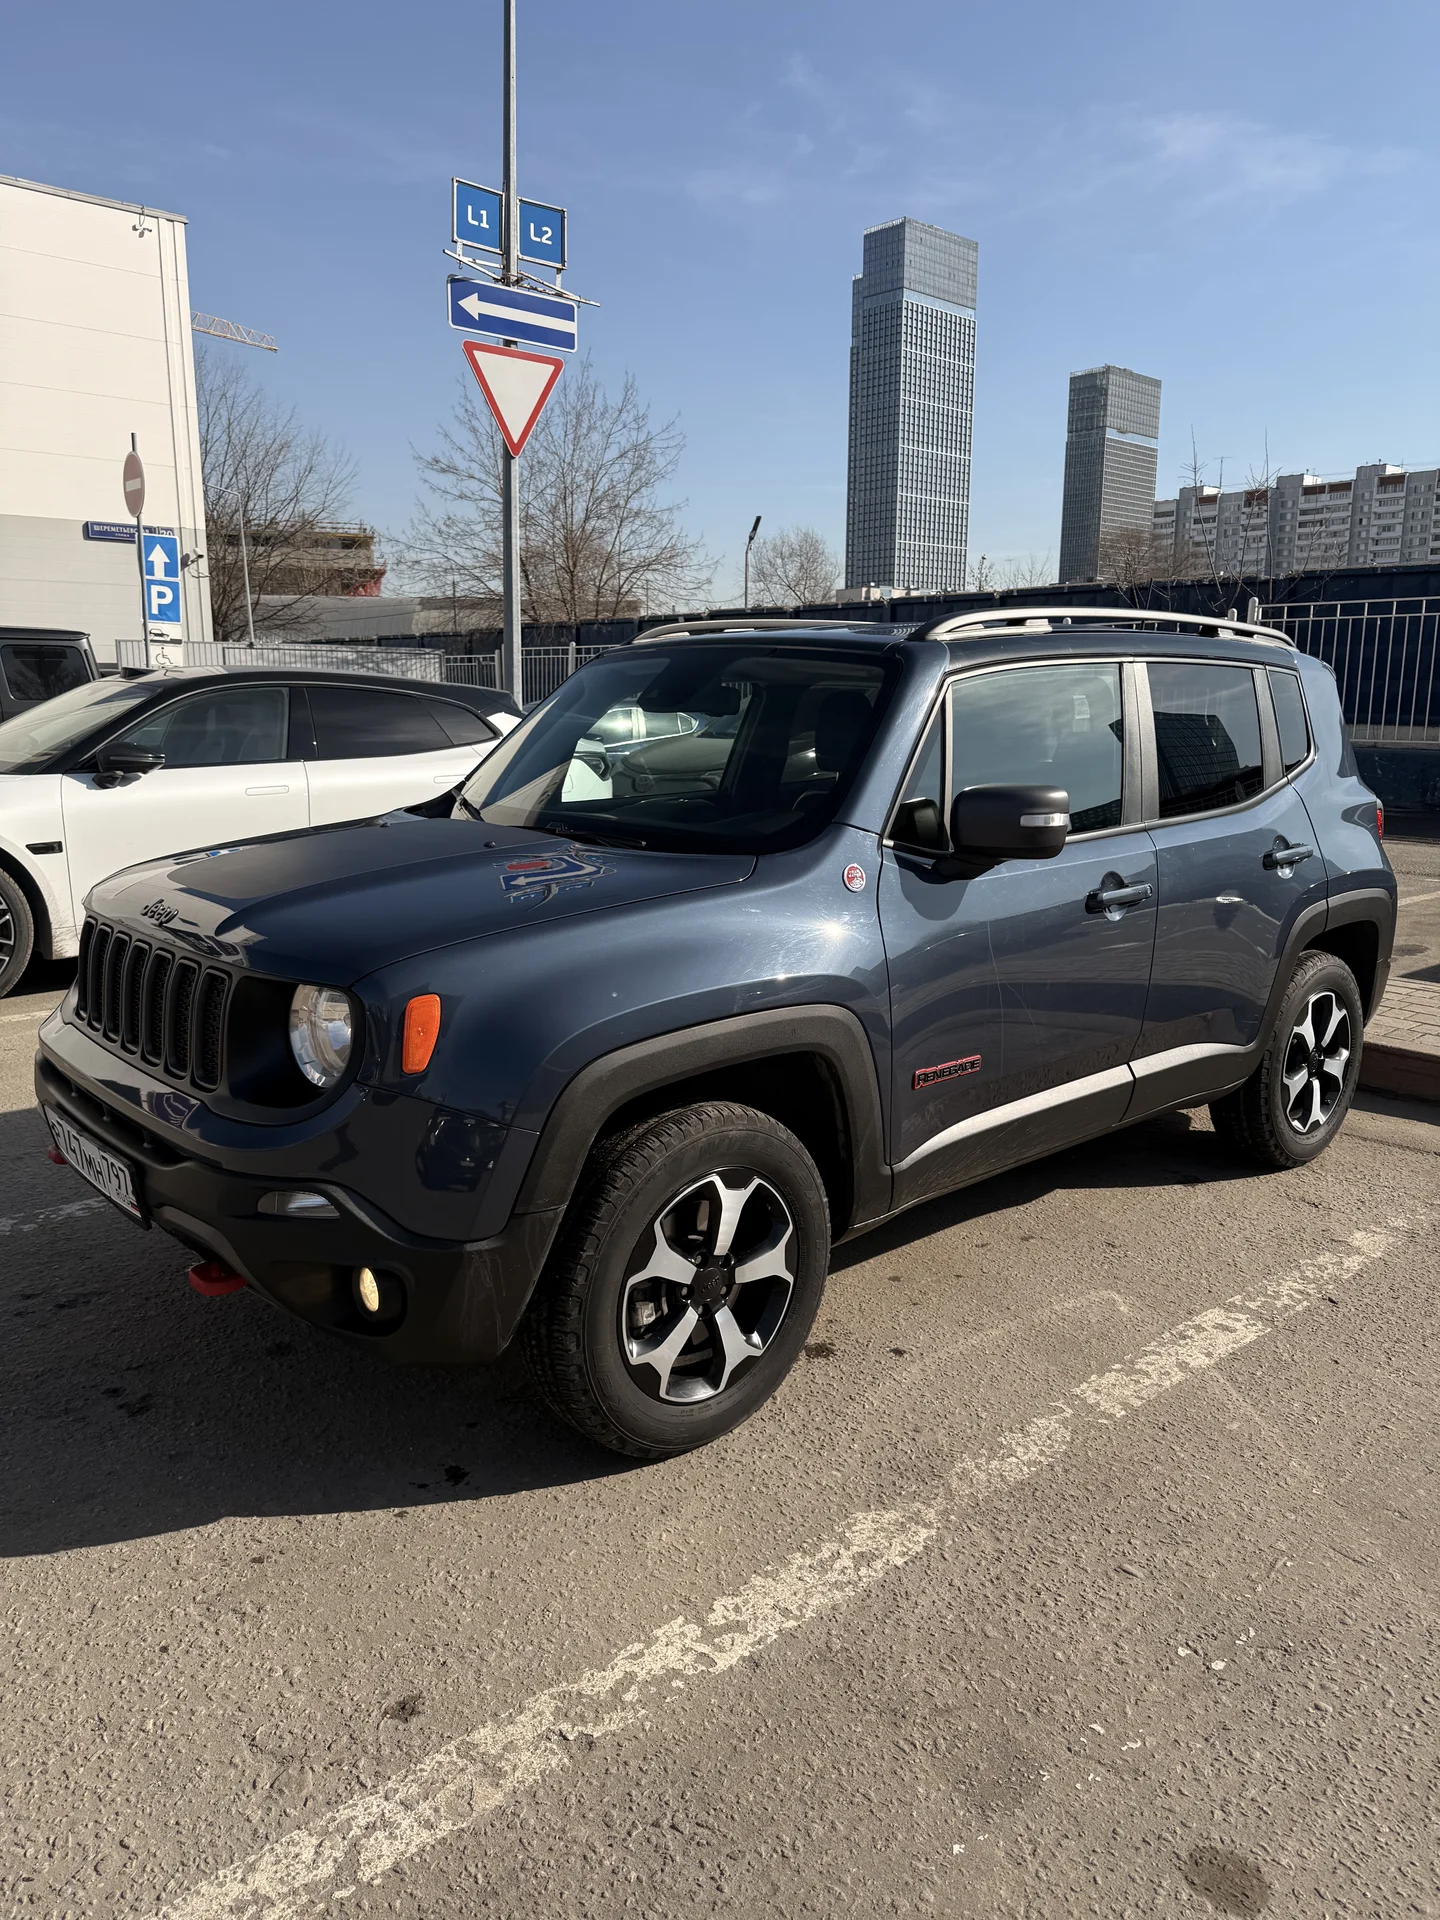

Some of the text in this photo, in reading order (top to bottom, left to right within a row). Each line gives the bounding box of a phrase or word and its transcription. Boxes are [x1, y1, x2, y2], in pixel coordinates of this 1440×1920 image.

[467, 204, 489, 229] L1
[529, 222, 552, 245] L2
[93, 524, 149, 534] ШЕРЕМЕТЬЕВСЯ
[150, 584, 173, 615] P
[140, 898, 179, 926] Jeep
[914, 1055, 982, 1089] RENEGADE
